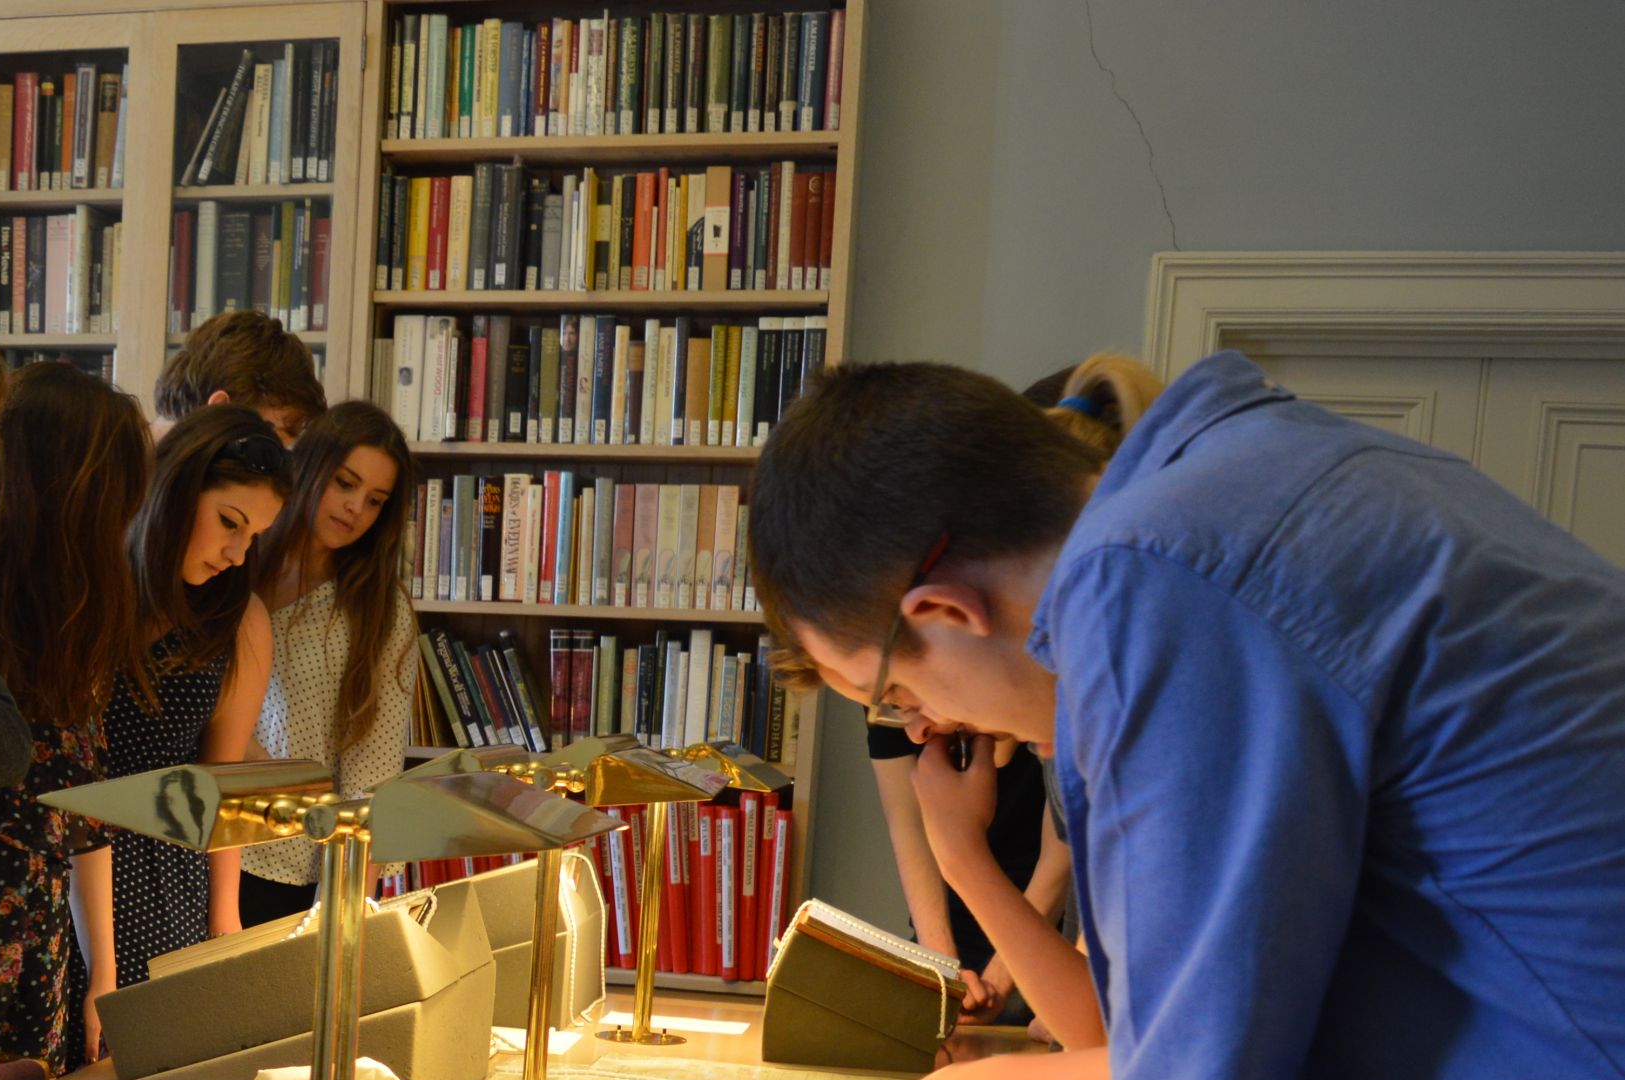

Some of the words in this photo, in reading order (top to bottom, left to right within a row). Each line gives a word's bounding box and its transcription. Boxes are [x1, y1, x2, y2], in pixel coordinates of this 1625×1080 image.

[505, 518, 522, 555] EVELYN
[435, 631, 454, 667] Virginia
[448, 663, 467, 693] Woolf
[770, 696, 783, 760] WINDHAM
[747, 809, 755, 833] SMALL
[766, 808, 774, 837] TURING
[745, 835, 754, 886] COLLECTIONS
